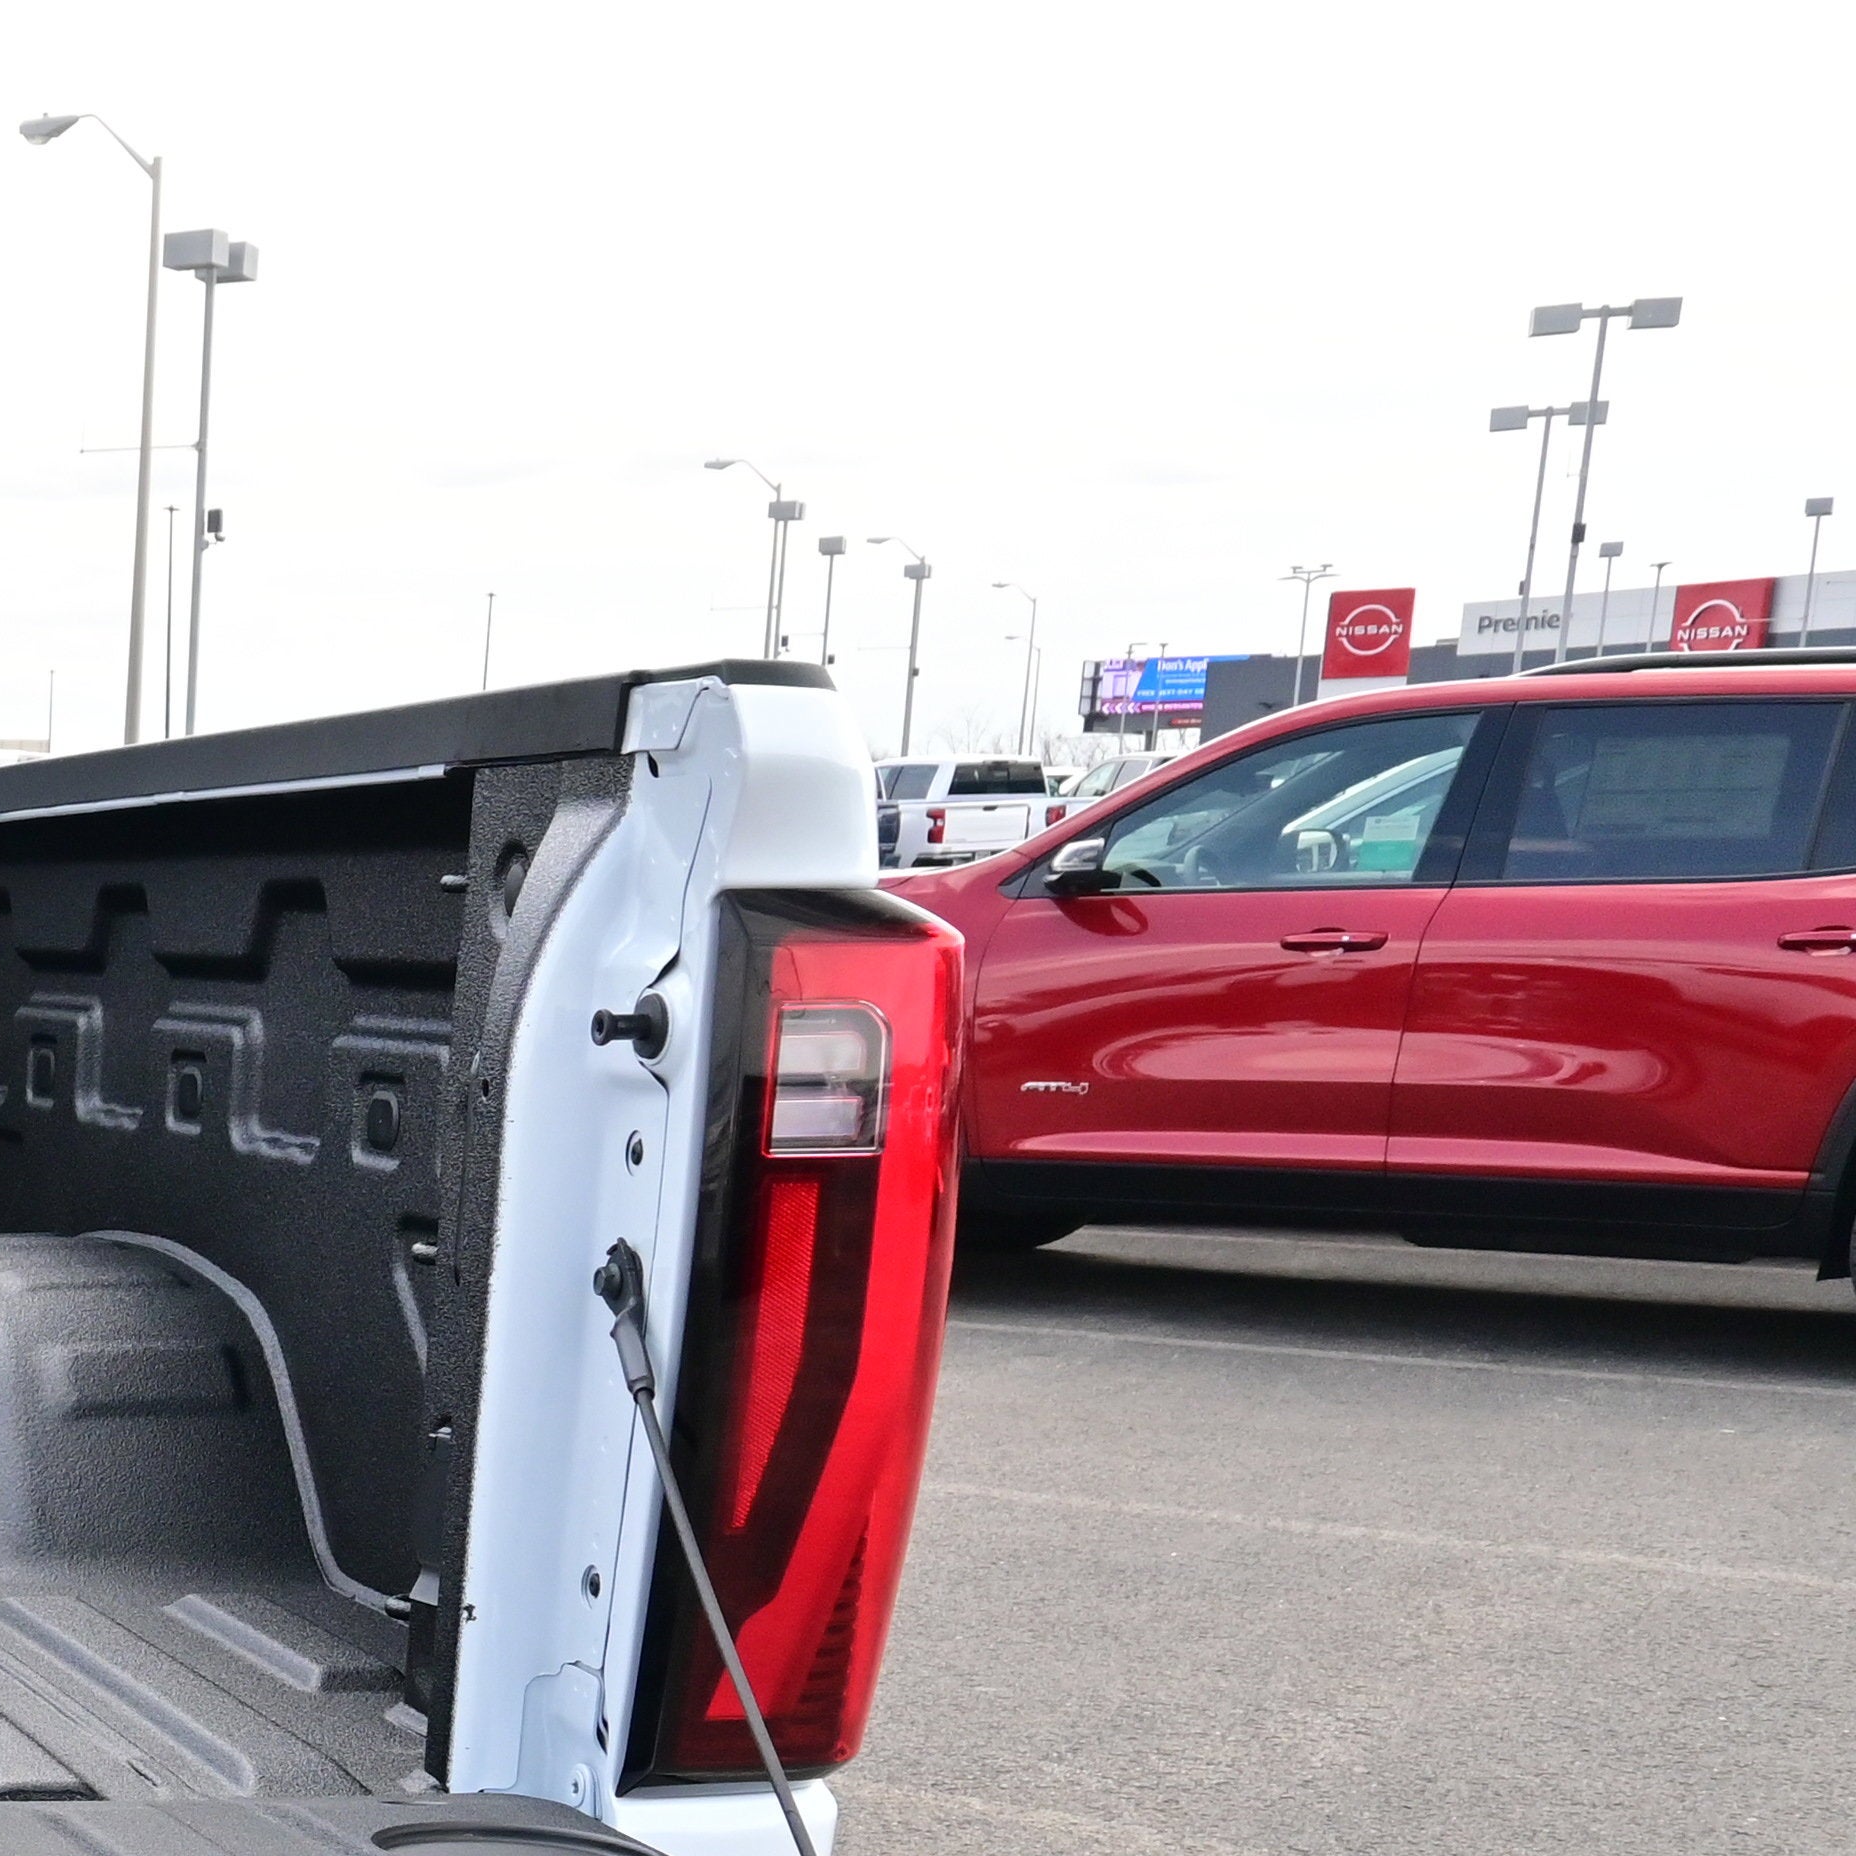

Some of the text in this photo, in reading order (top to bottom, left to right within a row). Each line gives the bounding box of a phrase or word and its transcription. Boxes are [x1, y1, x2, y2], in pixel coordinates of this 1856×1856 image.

[1478, 609, 1562, 633] Premie
[1336, 624, 1403, 636] NISSAN
[1677, 624, 1748, 641] NISSAN
